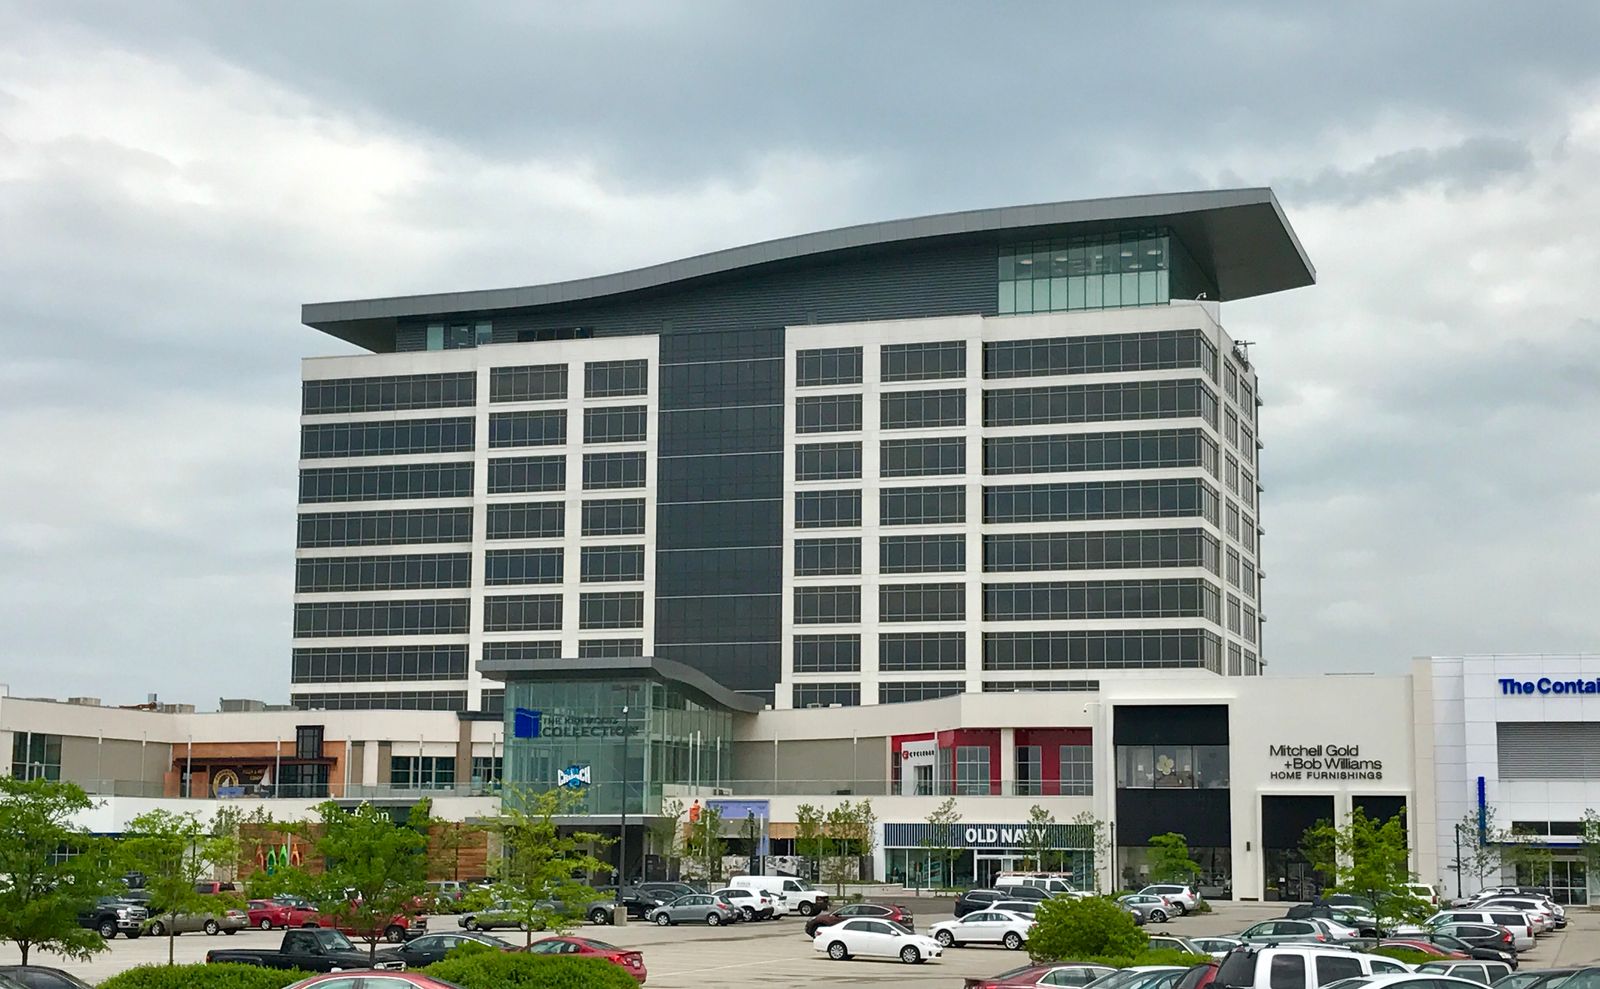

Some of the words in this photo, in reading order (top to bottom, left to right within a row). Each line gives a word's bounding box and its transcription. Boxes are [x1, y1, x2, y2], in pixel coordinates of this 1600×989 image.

[1498, 678, 1535, 695] The
[543, 717, 560, 725] THE
[542, 726, 639, 738] COLLECTION
[1269, 744, 1322, 757] Mitchell
[1325, 744, 1359, 757] Gold
[1324, 757, 1382, 770] Williams
[1270, 771, 1302, 780] HOME
[1306, 771, 1383, 780] FURNISHINGS
[965, 828, 998, 843] OLD
[1001, 828, 1047, 844] NAVY
